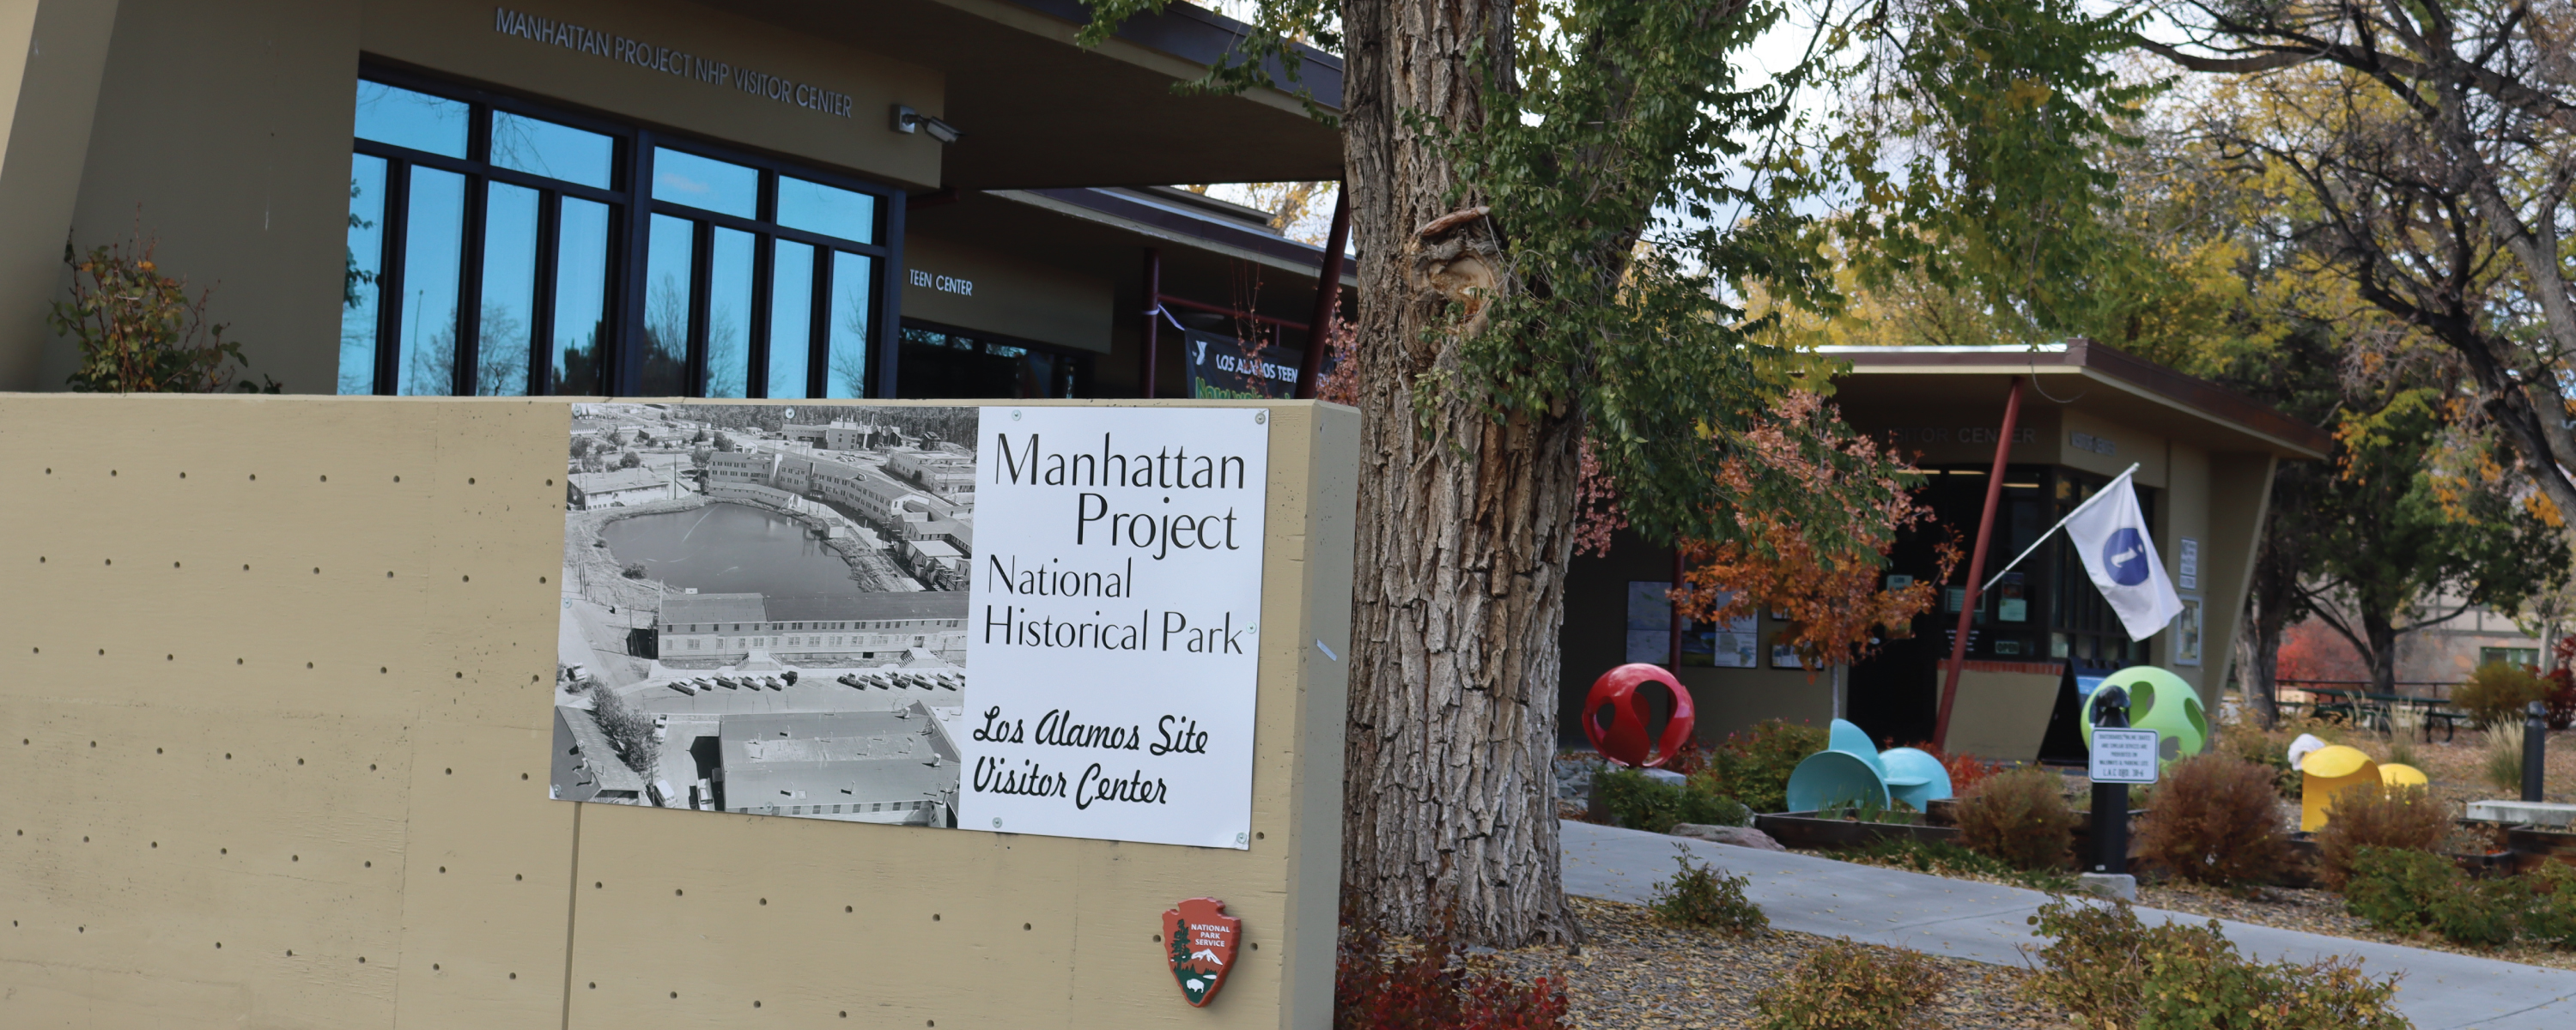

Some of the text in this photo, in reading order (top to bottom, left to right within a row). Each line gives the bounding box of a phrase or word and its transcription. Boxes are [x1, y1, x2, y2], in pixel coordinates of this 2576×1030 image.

[495, 7, 852, 118] MANHATTAN PROJECT NHP VISITOR CENTER
[908, 269, 973, 297] TEEN CENTER
[1216, 354, 1236, 373] LOS
[1235, 358, 1276, 379] ALAOS
[1277, 365, 1298, 384] TEEN
[1874, 427, 2036, 444] VSITOR CENER
[996, 433, 1243, 488] Manhattan
[1078, 494, 1238, 560] Project
[989, 554, 1131, 597] National
[986, 605, 1242, 654] Historical Park
[974, 706, 1207, 755] Los Alamos Site
[974, 756, 1166, 809] Visitor Center
[1191, 924, 1230, 933] NATIONAL
[1195, 939, 1225, 948] SERVICE
